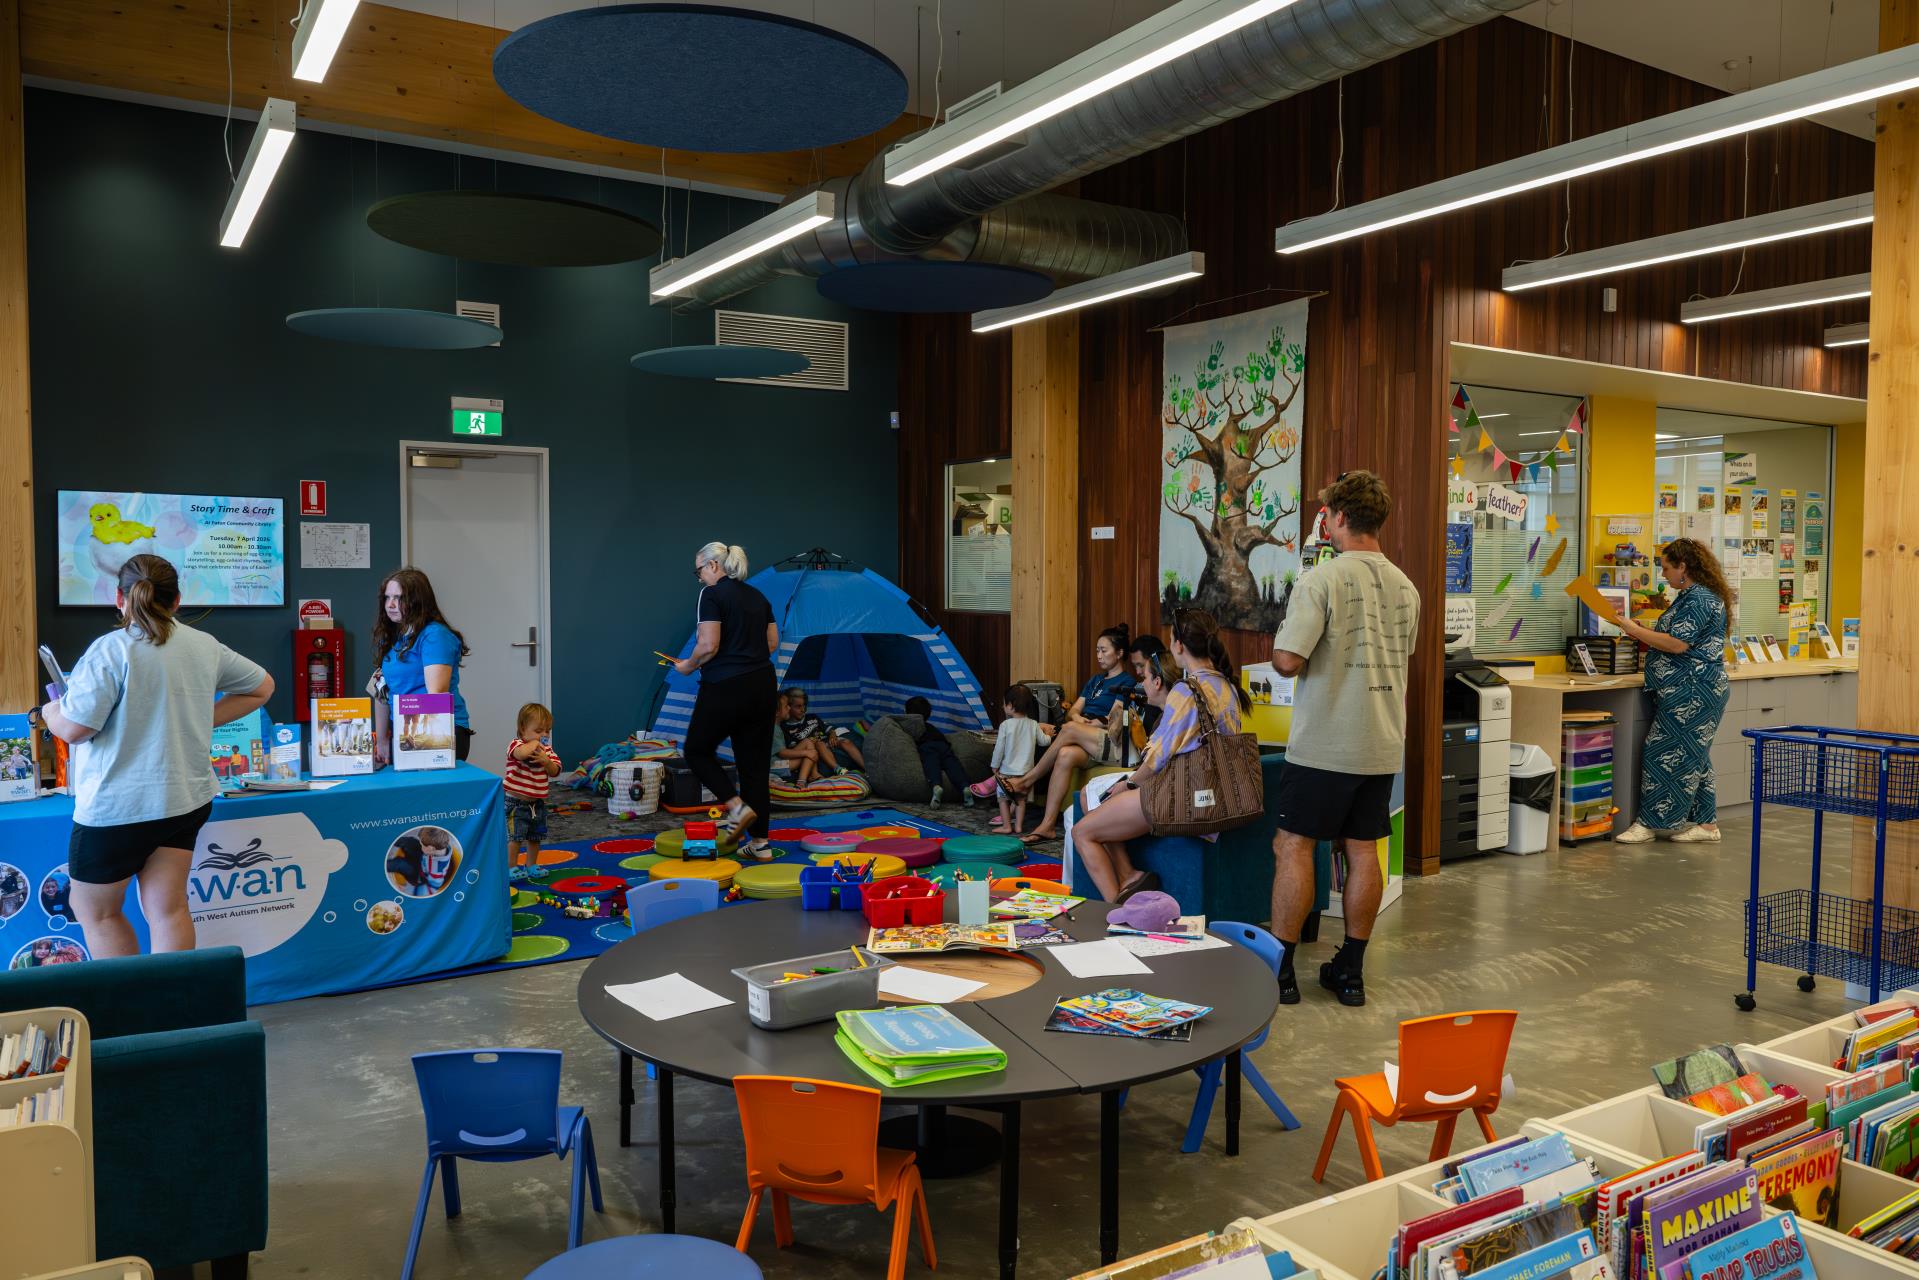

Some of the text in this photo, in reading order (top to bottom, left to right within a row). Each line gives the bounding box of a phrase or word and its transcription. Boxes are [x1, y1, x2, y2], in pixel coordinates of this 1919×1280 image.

[1448, 486, 1473, 504] ind a
[1488, 487, 1527, 516] feather?
[190, 504, 275, 515] Story Time & Craft
[350, 807, 481, 830] www.swanautism.org.au
[192, 902, 295, 923] uth West Autism Network
[1835, 1132, 1842, 1143] G
[1748, 1177, 1756, 1189] G
[1661, 1187, 1752, 1248] MAXINE
[1782, 1218, 1791, 1231] G
[1678, 1240, 1699, 1256] BOB
[1701, 1222, 1741, 1245] GRAHAM
[1581, 1243, 1588, 1255] F
[1744, 1235, 1803, 1277] TRUCKS
[1534, 1251, 1571, 1275] FOREMAN
[1600, 1266, 1607, 1278] F
